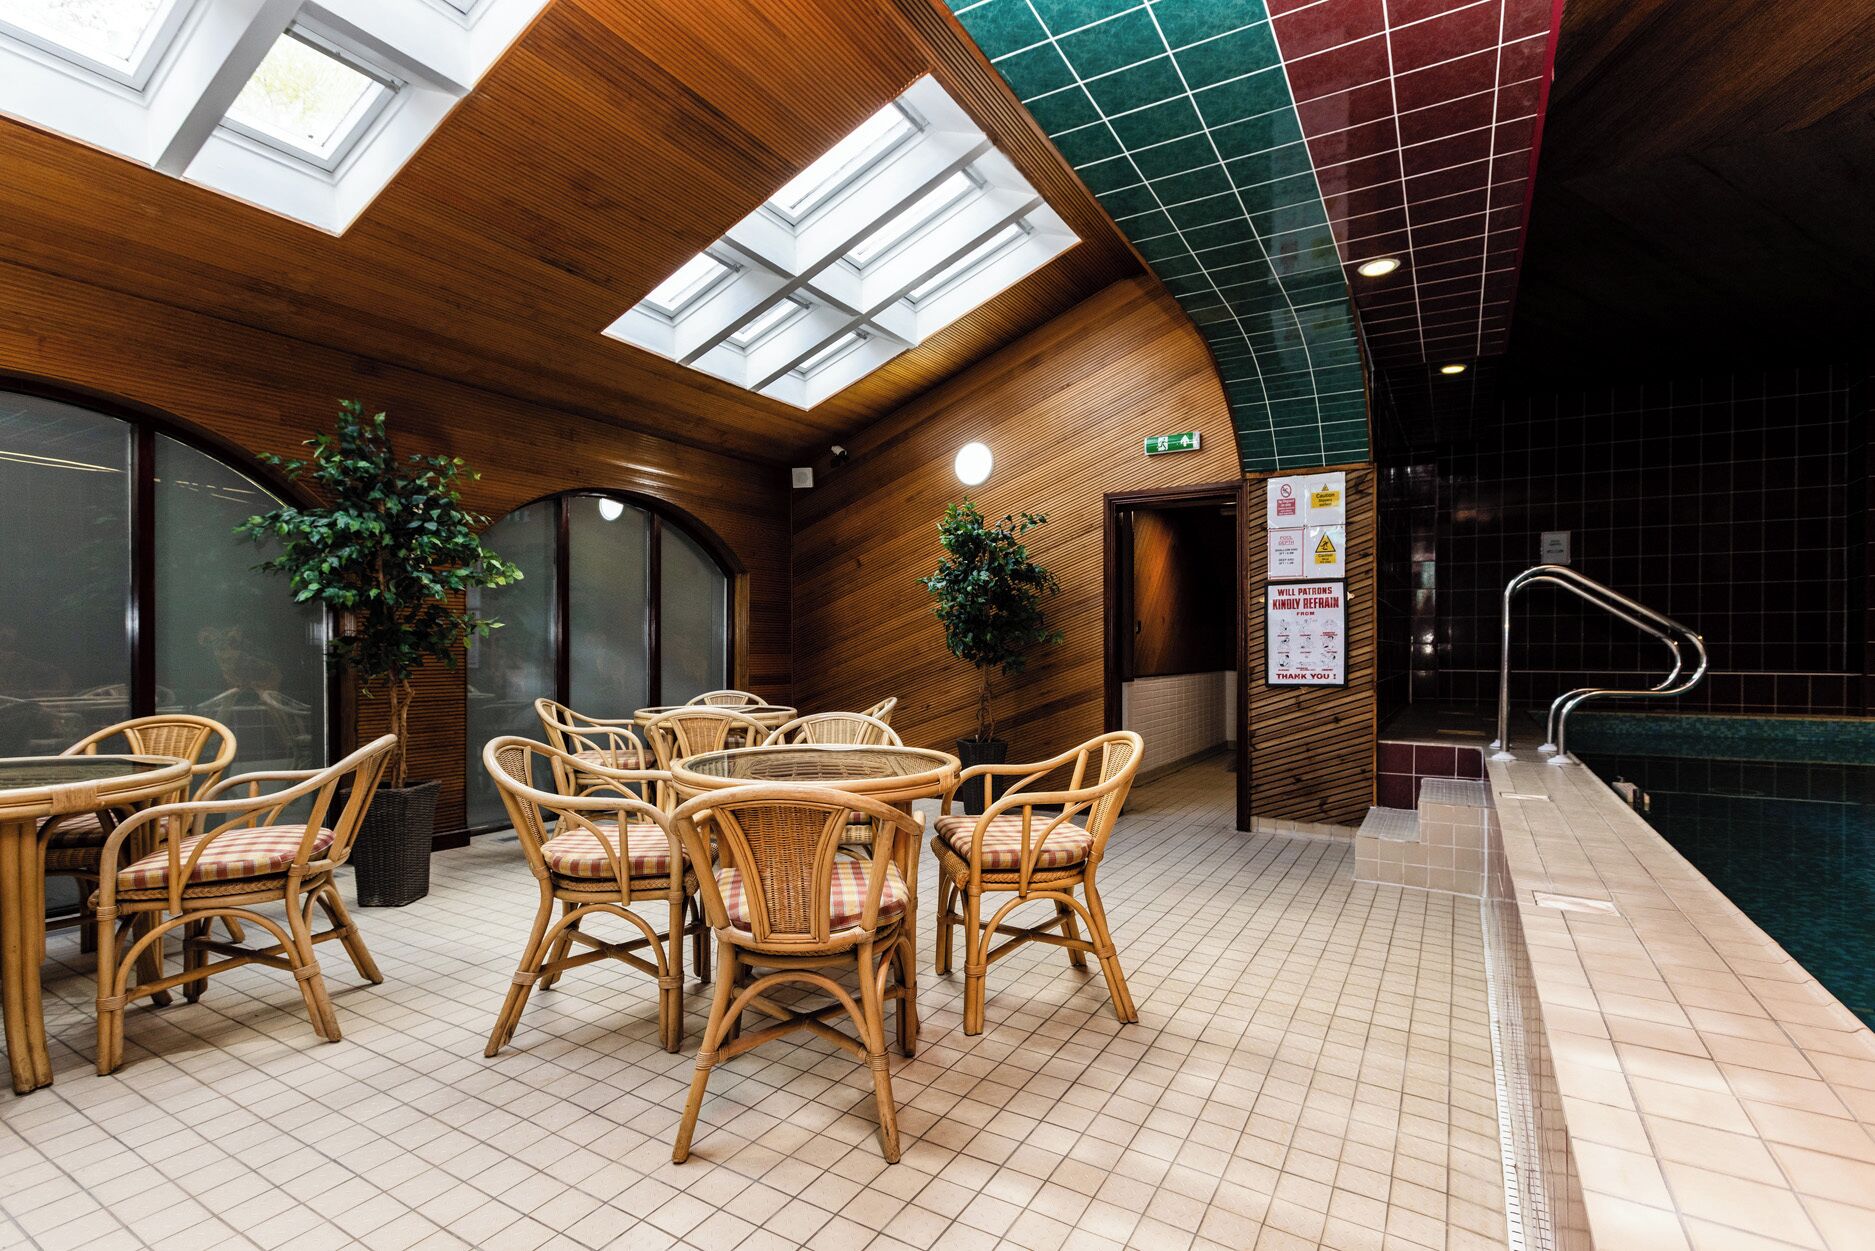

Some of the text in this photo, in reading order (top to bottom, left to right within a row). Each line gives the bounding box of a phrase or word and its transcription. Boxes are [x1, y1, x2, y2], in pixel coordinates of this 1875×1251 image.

[1277, 587, 1332, 596] WILL PATRONS
[1273, 597, 1339, 610] KINDLY REFRAIN
